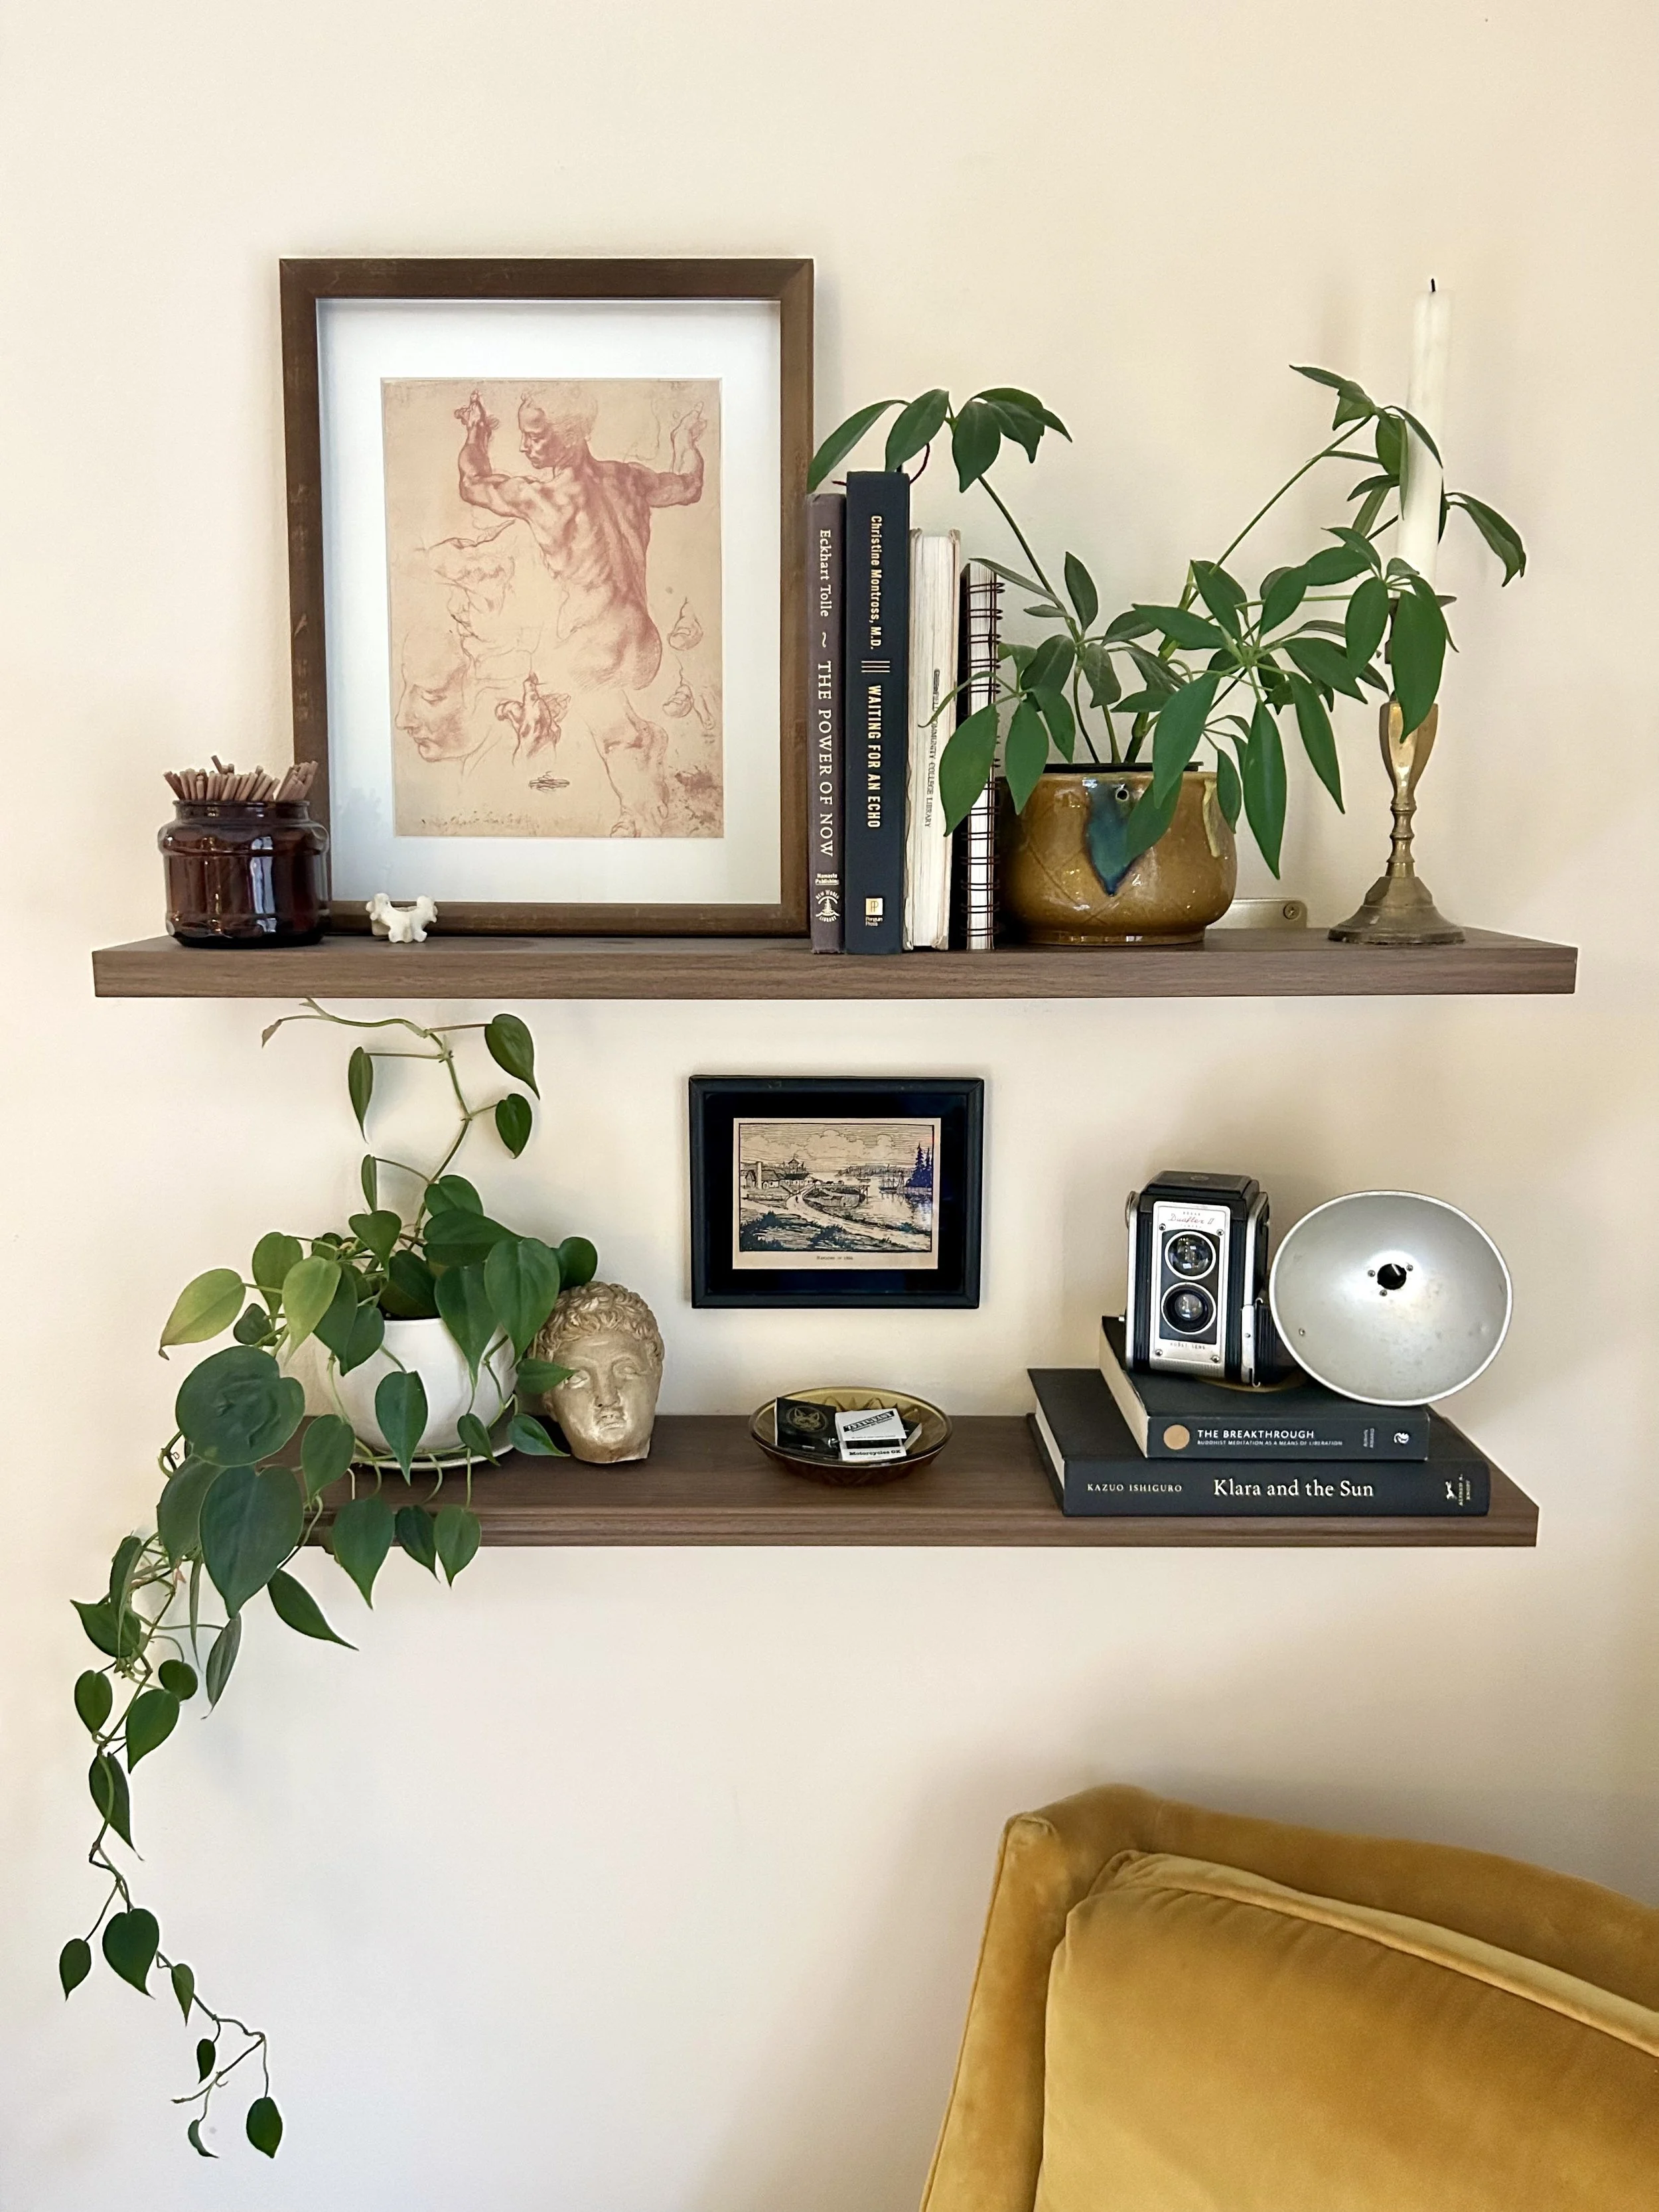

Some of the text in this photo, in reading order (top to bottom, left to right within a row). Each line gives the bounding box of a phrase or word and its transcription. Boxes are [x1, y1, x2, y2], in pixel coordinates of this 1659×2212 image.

[820, 529, 832, 617] Eckhart Tolle
[869, 515, 883, 650] Christine Montross, M.D.
[818, 660, 833, 857] THE POWER OF NOW
[867, 685, 882, 828] WAITING FOR AN ECHO
[926, 761, 936, 795] COLLEGE
[924, 798, 933, 828] LIBRARY
[1197, 1430, 1314, 1439] THE BREAKTHROUGH
[1087, 1483, 1183, 1493] KAZUO ISHIGURO
[1213, 1478, 1374, 1497] Klara and the Sun
